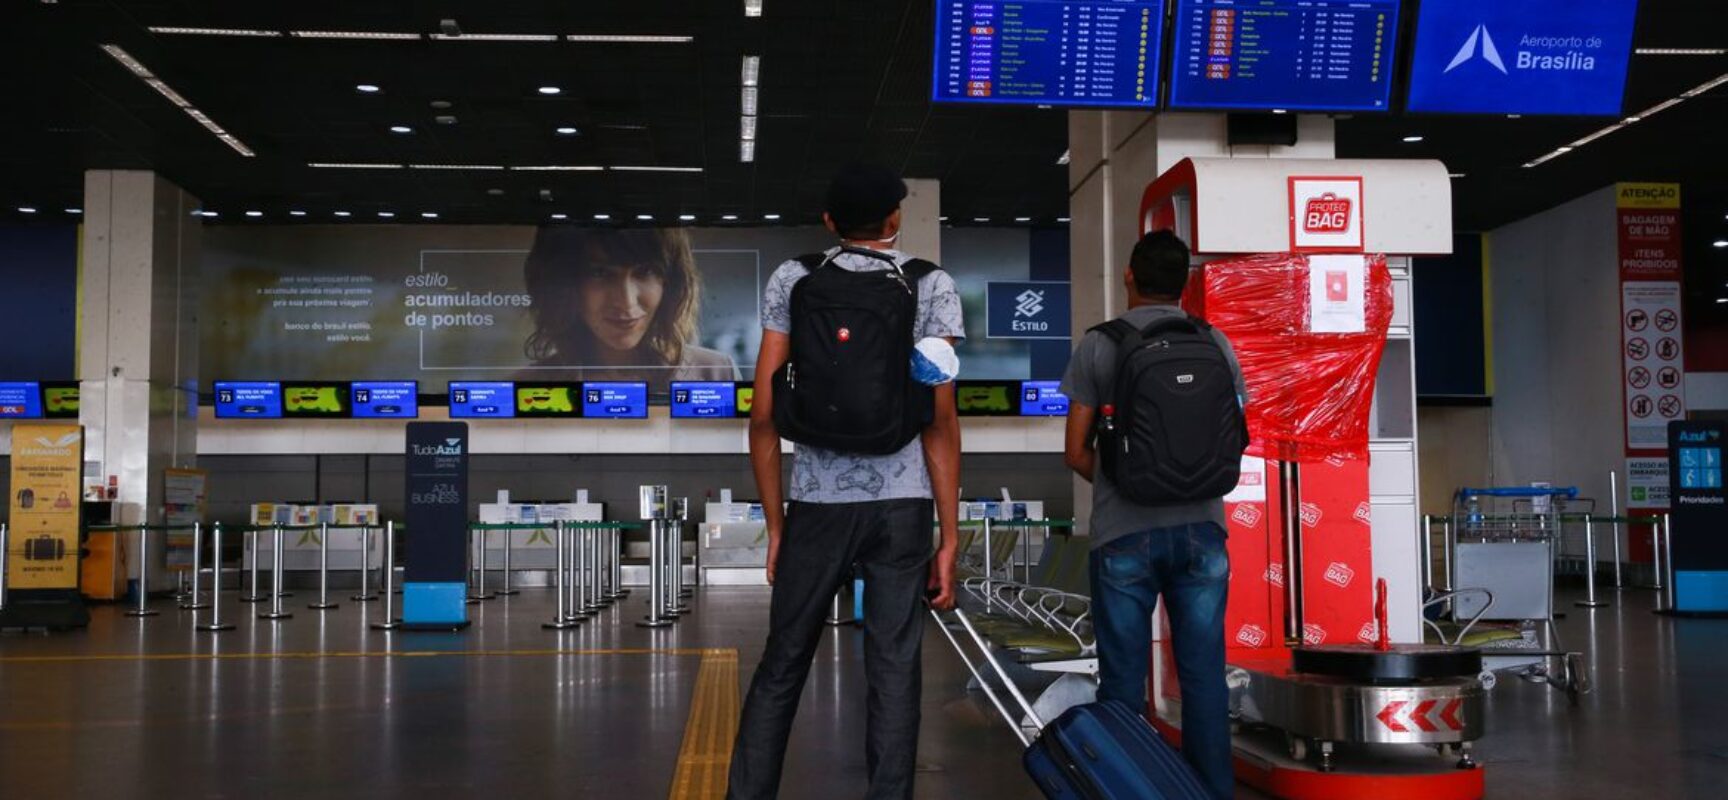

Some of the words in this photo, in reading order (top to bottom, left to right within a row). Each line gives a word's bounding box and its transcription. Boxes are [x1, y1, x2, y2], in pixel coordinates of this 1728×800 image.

[1519, 34, 1582, 50] Aeroporto
[1585, 36, 1602, 48] de
[1516, 51, 1595, 71] Brasília
[1620, 186, 1675, 199] ATENÇÃO
[1309, 202, 1346, 212] PROTEC
[1307, 212, 1346, 228] BAG
[1622, 215, 1676, 225] BAGAGEM
[1628, 225, 1643, 235] DE
[1645, 224, 1670, 235] MÃO
[1635, 249, 1665, 258] ITENS
[1622, 259, 1678, 269] PROIBIDOS
[404, 292, 533, 307] acumuladores
[285, 322, 310, 330] banco
[405, 311, 427, 326] de
[431, 313, 494, 330] pontos
[1012, 320, 1048, 332] ESTILO
[221, 394, 231, 403] 73
[357, 394, 367, 402] 74
[455, 394, 466, 403] 75
[588, 394, 599, 403] 76
[676, 394, 686, 403] 77
[1679, 431, 1706, 441] Azul
[412, 444, 461, 456] TudoAzul
[411, 493, 460, 504] BUSINESS
[1679, 496, 1724, 504] Prioridades
[1234, 510, 1255, 525] BAG
[1327, 569, 1348, 584] BAG
[1239, 631, 1260, 645] BAG
